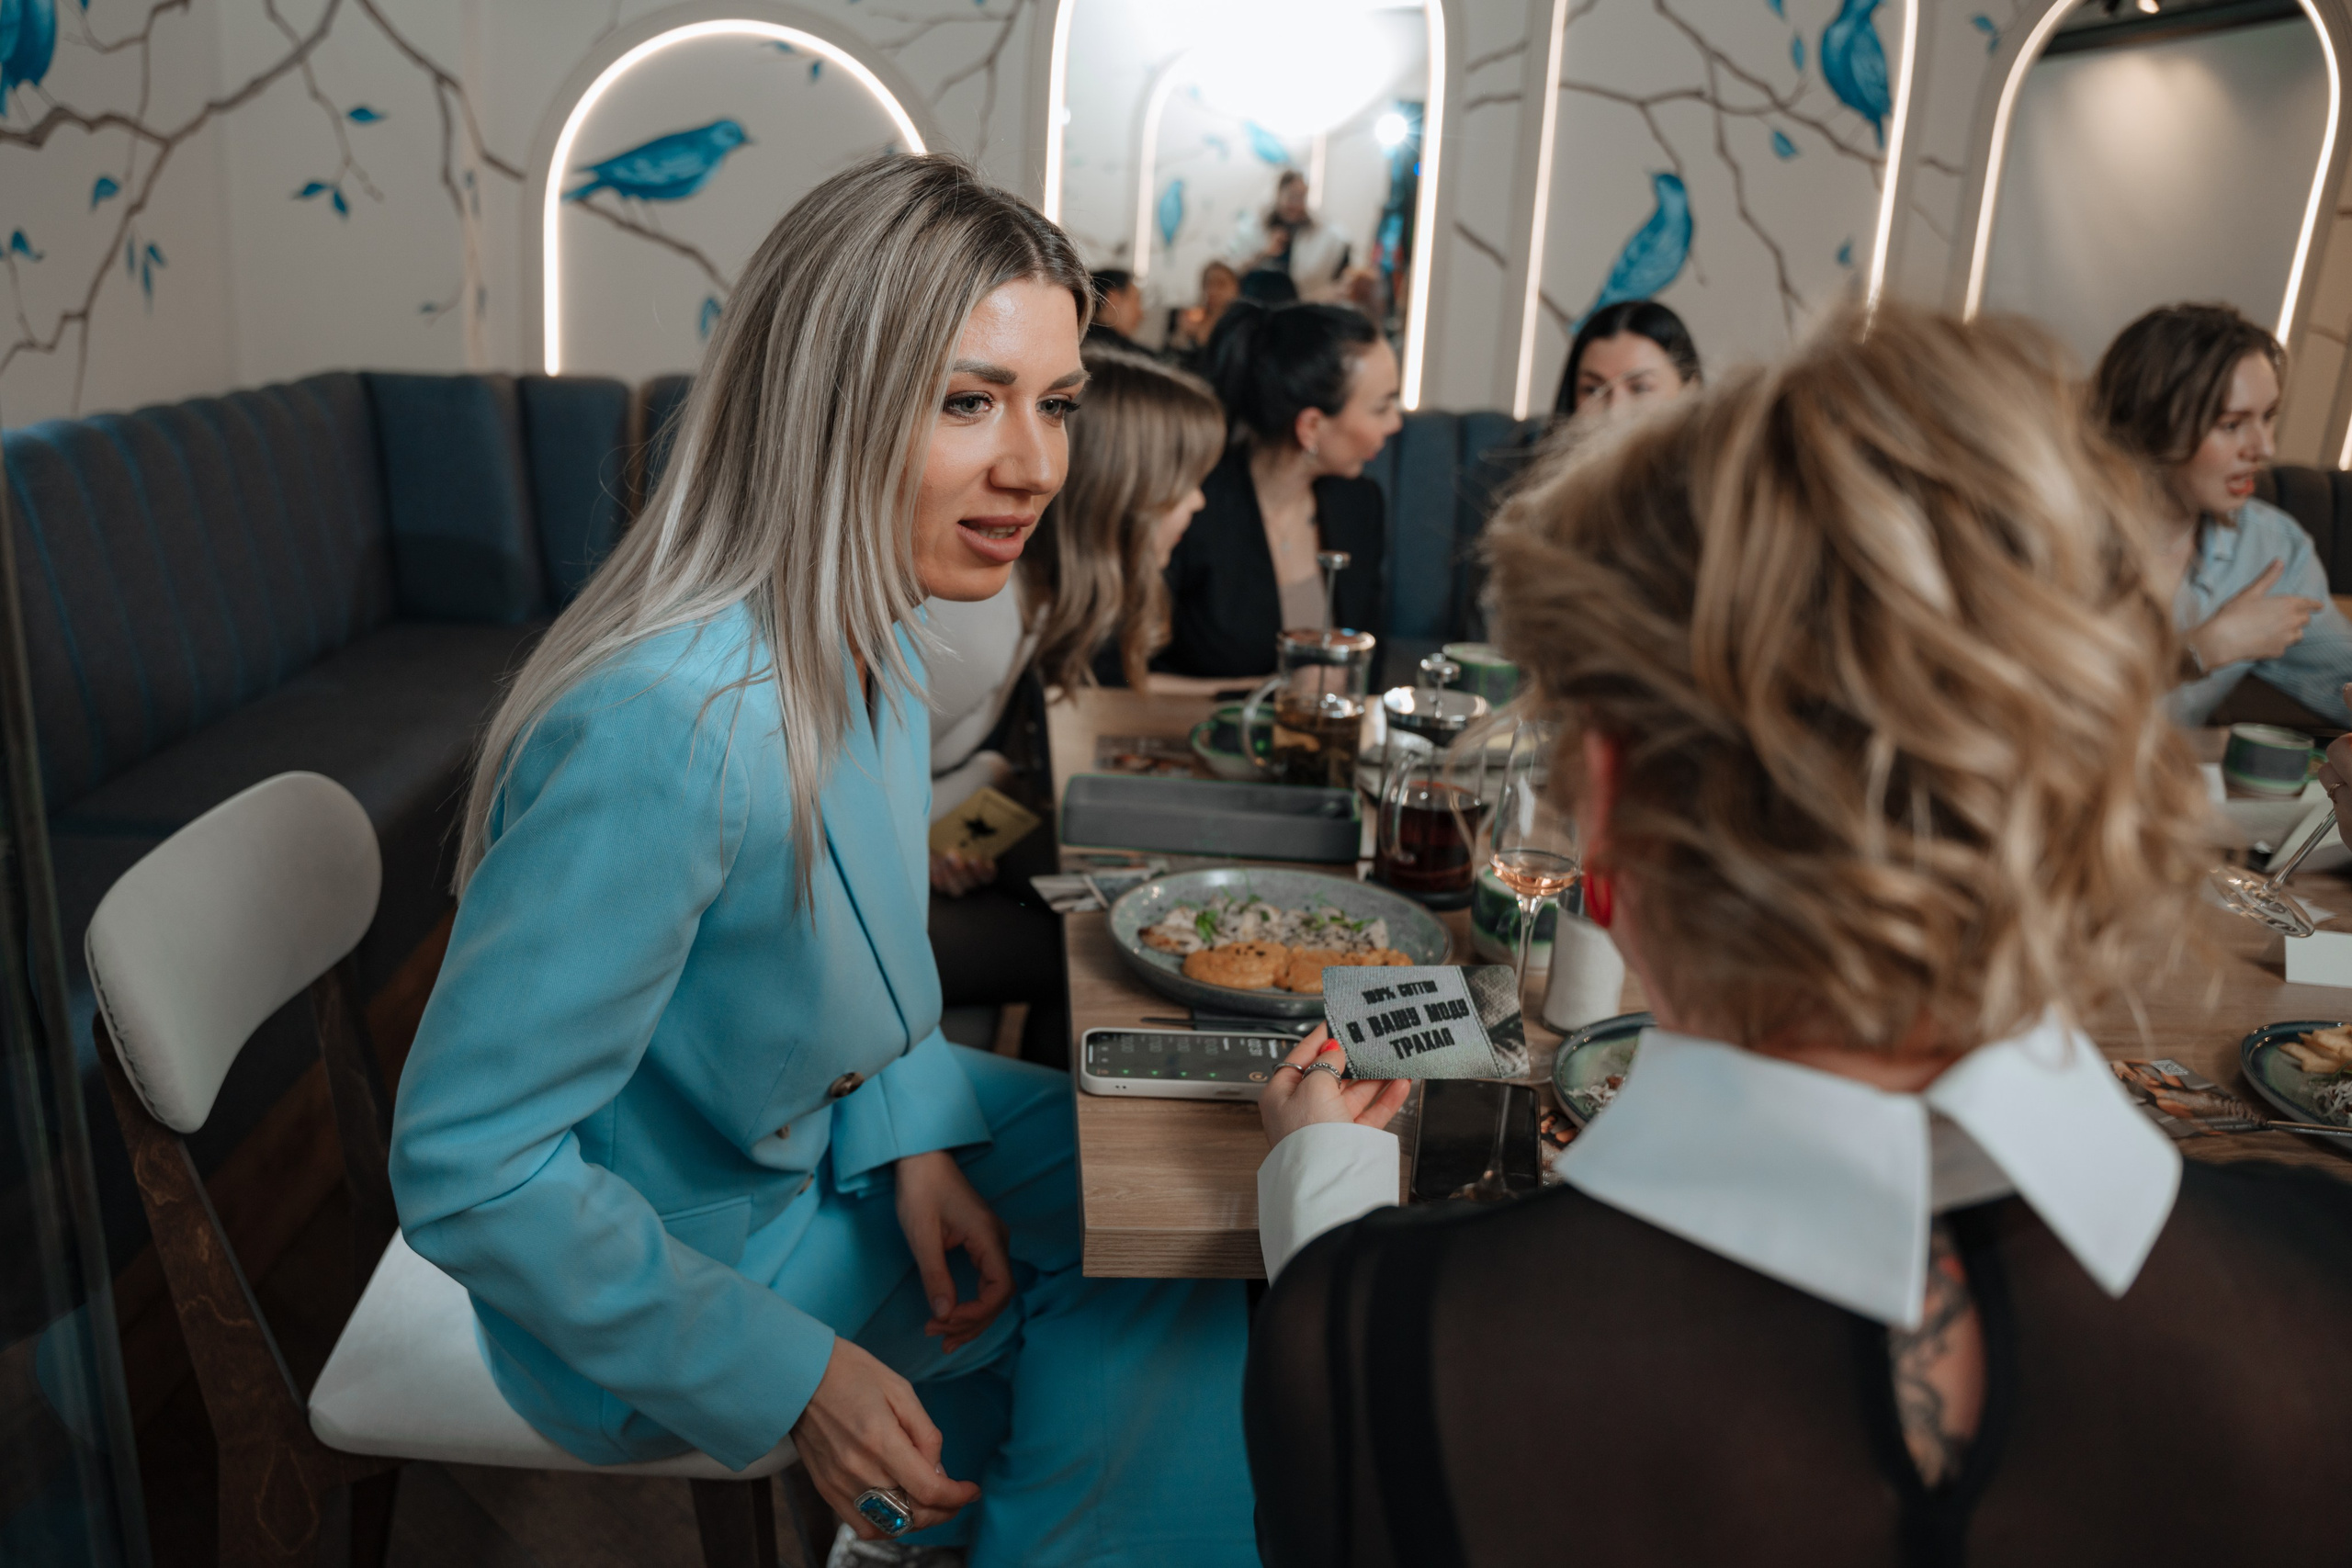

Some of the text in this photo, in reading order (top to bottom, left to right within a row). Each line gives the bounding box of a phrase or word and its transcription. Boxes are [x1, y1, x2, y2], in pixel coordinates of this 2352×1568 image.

[1346, 998, 1470, 1043] Я ВАШУ МОДУ
[1389, 1027, 1455, 1059] ТРАХАЛ
